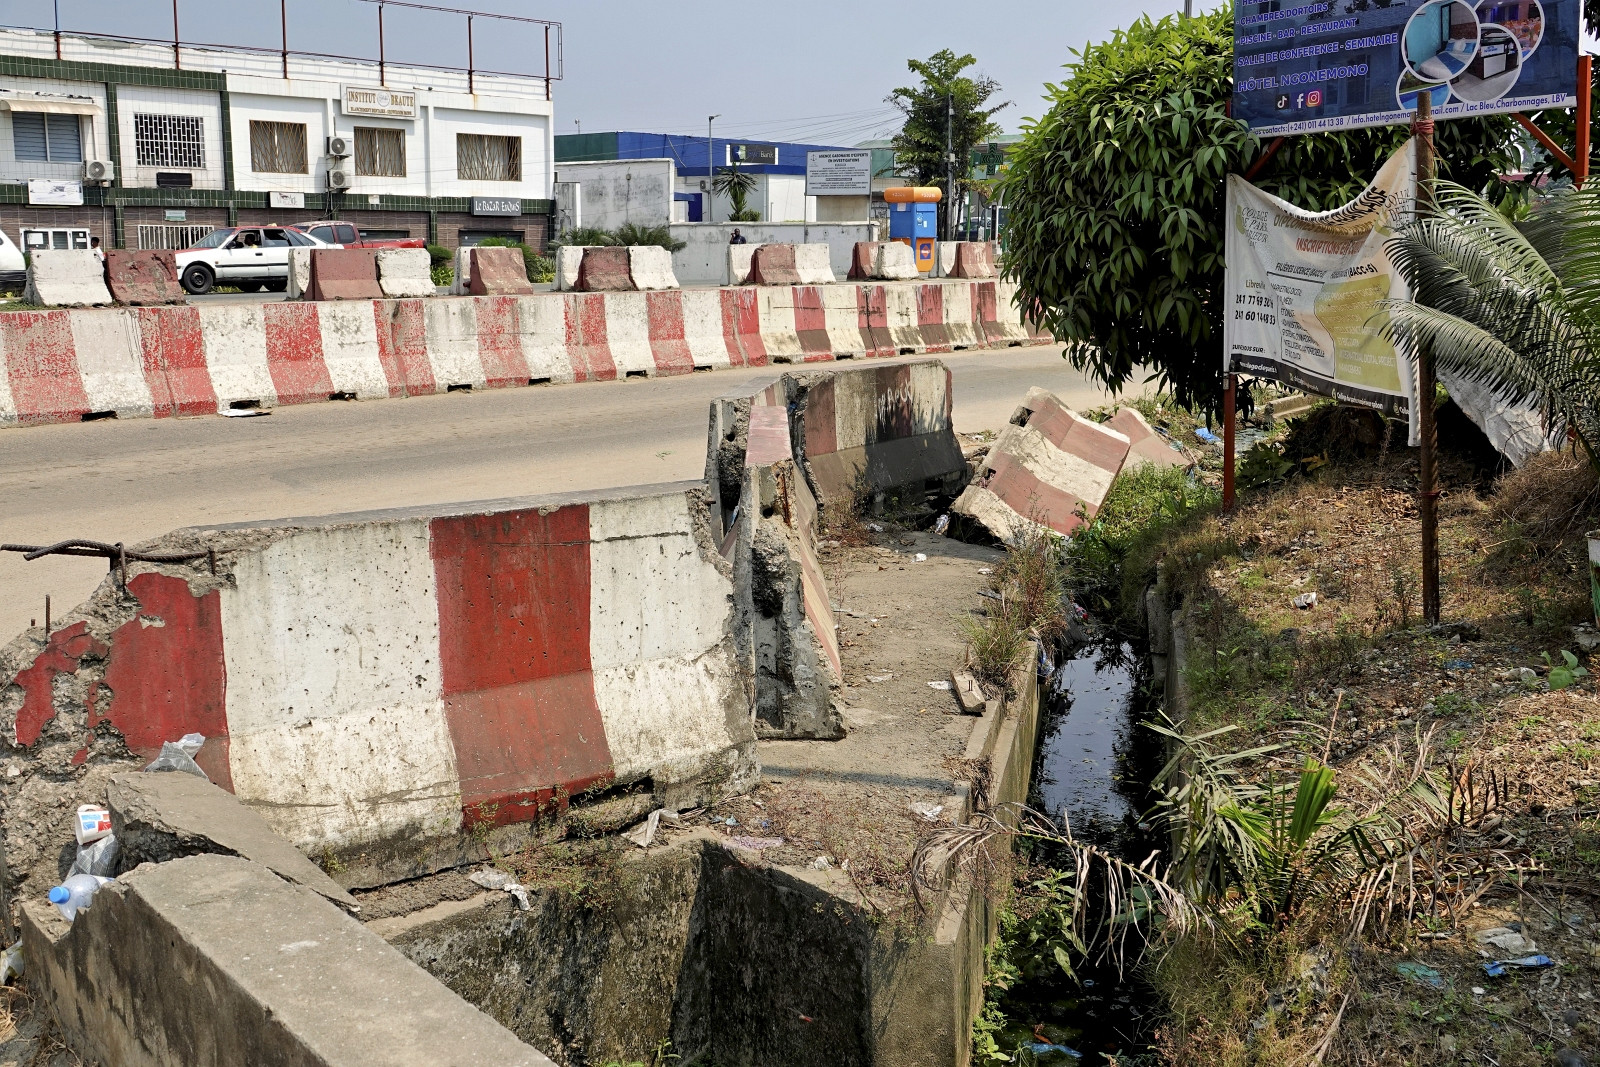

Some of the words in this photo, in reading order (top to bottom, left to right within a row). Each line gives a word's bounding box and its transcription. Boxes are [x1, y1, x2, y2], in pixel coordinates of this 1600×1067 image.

[1240, 11, 1285, 25] CHAMBRES
[1286, 3, 1328, 18] DORTOIRS
[1240, 33, 1272, 45] PISCINE
[1278, 28, 1295, 39] BAR
[1301, 18, 1357, 35] RESTAURANT
[1238, 54, 1264, 67] SALLE
[1266, 52, 1278, 62] DE
[1279, 42, 1339, 60] CONFERENCE
[1345, 33, 1398, 50] SEMINAIRE
[1238, 76, 1278, 92] HÔTEL
[1280, 64, 1368, 86] NGONEMONO
[348, 91, 376, 104] INSTITUT
[1308, 119, 1317, 129] 011
[1318, 118, 1326, 128] 44
[1327, 118, 1334, 127] 13
[1335, 118, 1344, 126] 38
[1466, 103, 1478, 112] Lac
[1552, 93, 1567, 103] LBV
[1245, 311, 1256, 320] 60
